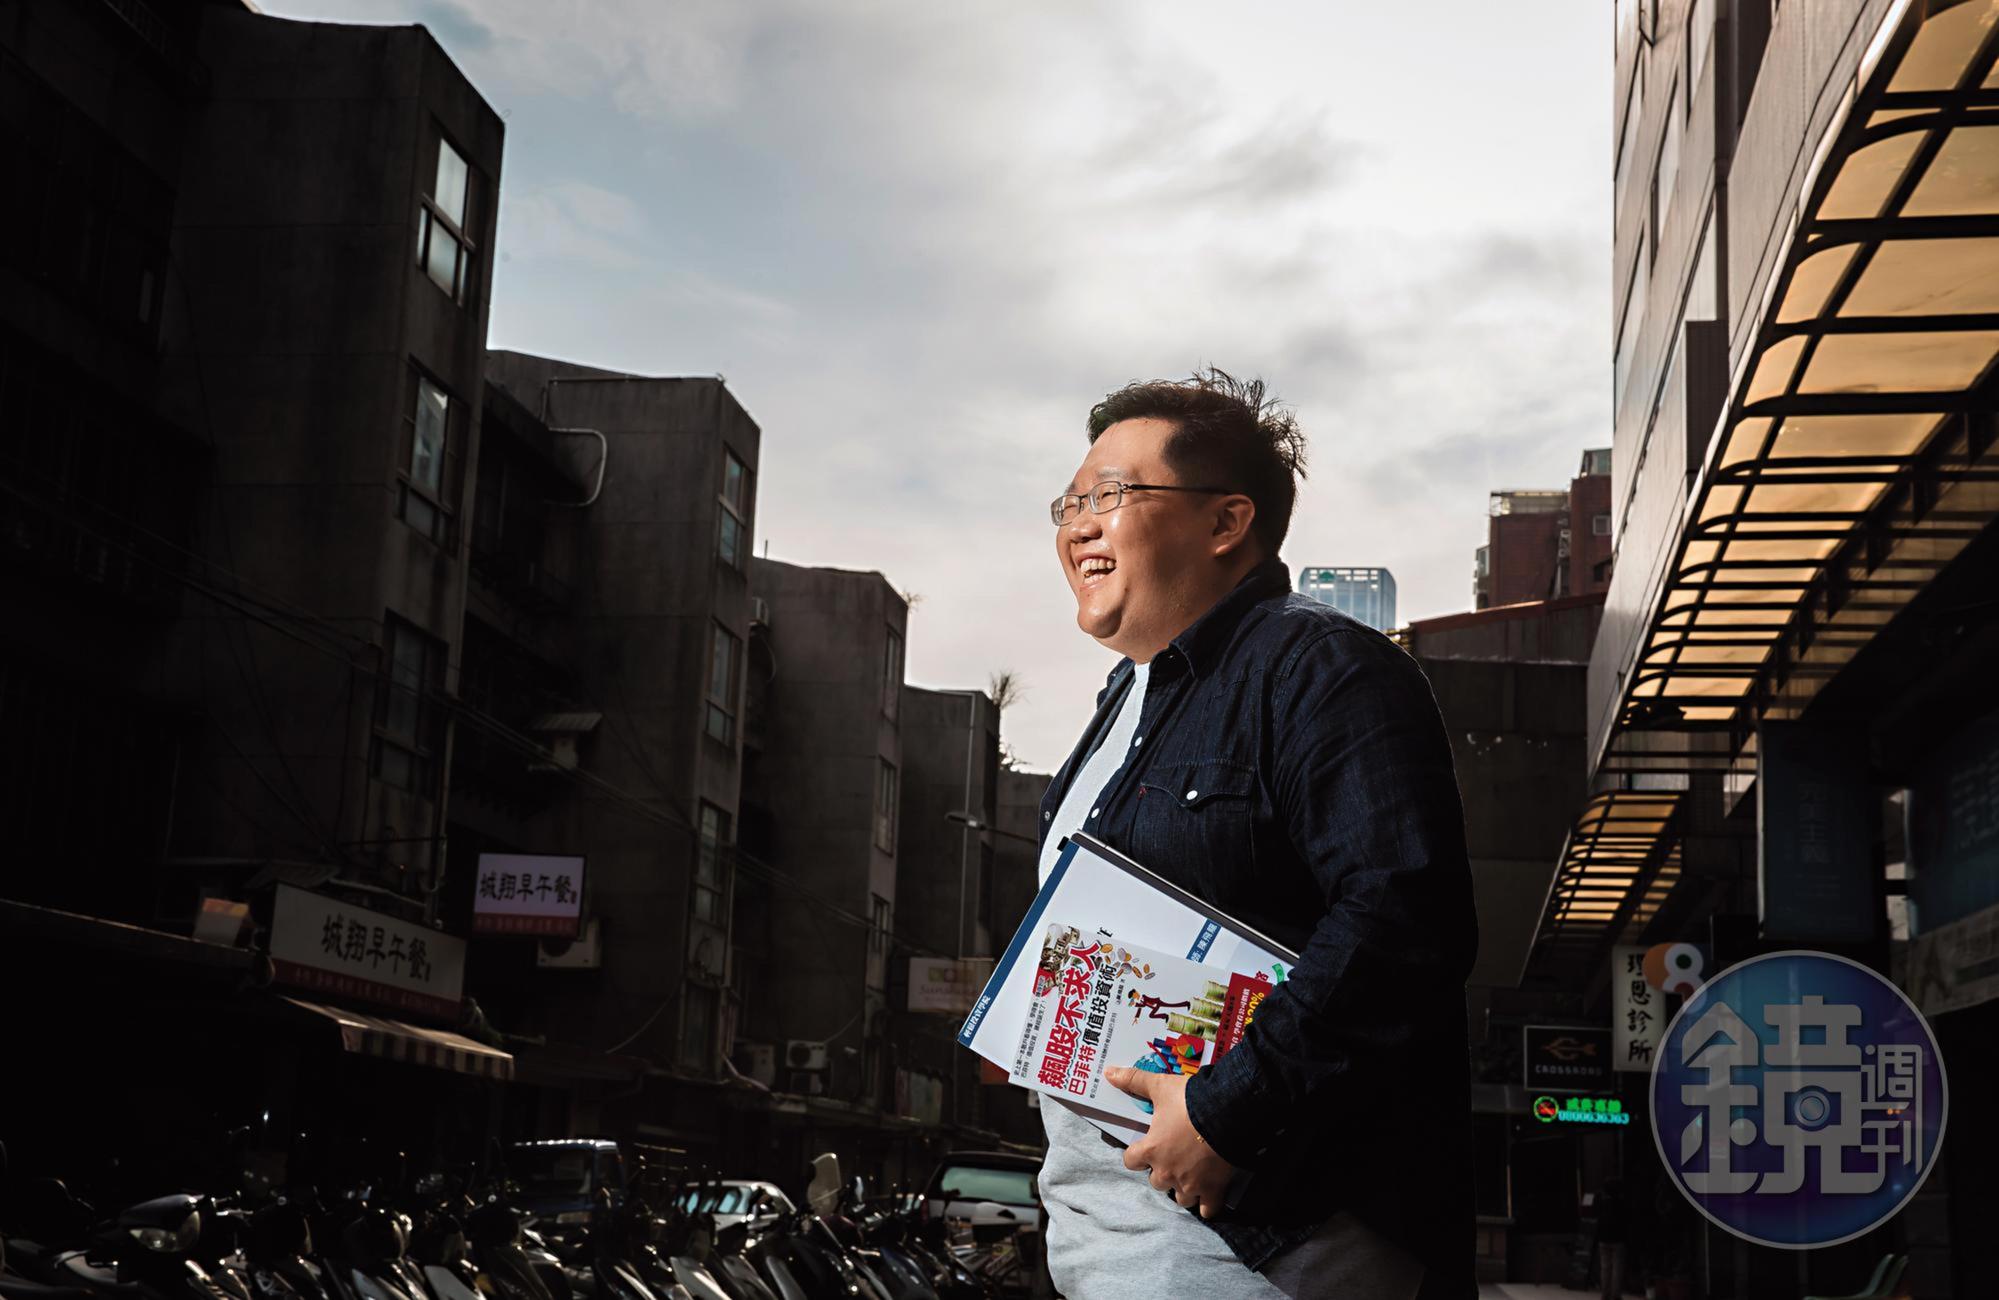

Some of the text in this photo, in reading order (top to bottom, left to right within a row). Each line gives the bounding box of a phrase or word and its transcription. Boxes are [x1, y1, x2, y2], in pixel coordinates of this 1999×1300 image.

[479, 872, 569, 903] 城翔早午餐
[320, 913, 428, 980] 城翔早午餐
[1037, 942, 1100, 1089] 飆股不求人
[1068, 963, 1117, 1095] 巴菲特價值投資術
